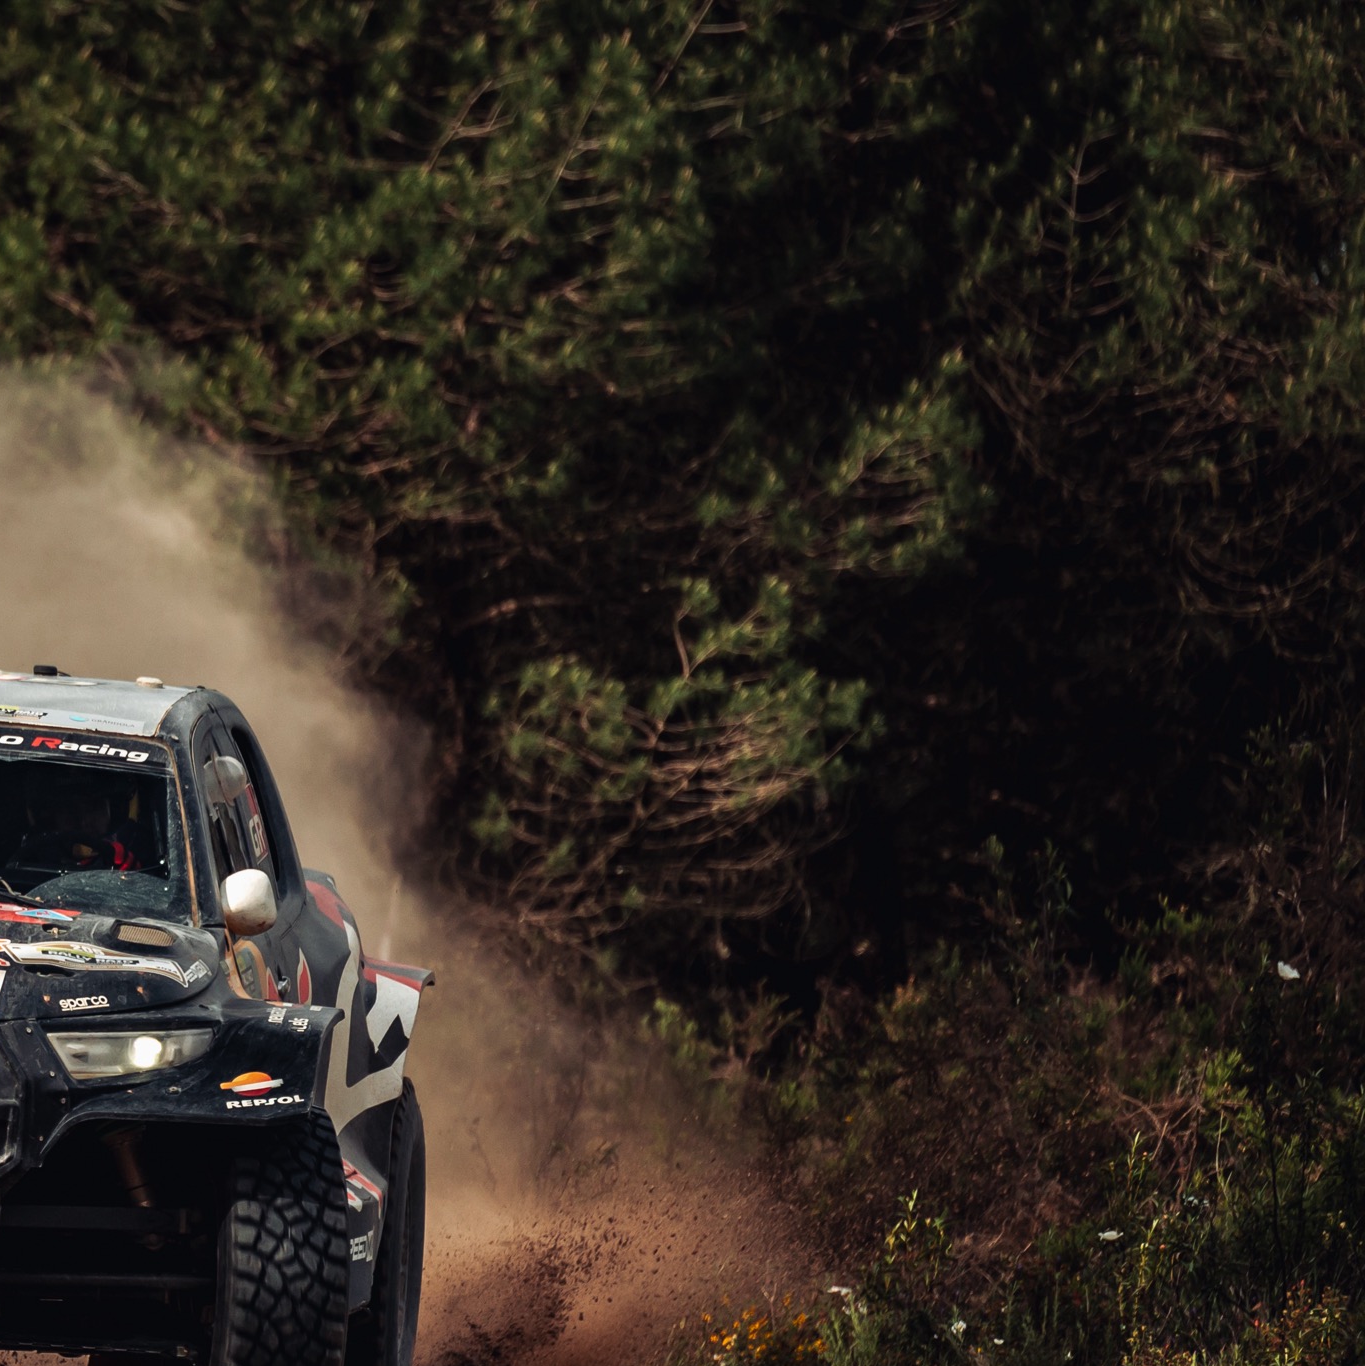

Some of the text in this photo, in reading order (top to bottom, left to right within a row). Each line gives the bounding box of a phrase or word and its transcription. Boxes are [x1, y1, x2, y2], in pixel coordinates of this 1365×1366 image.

[31, 736, 150, 763] Racing
[59, 994, 109, 1011] sparco
[226, 1094, 305, 1109] REPSOL
